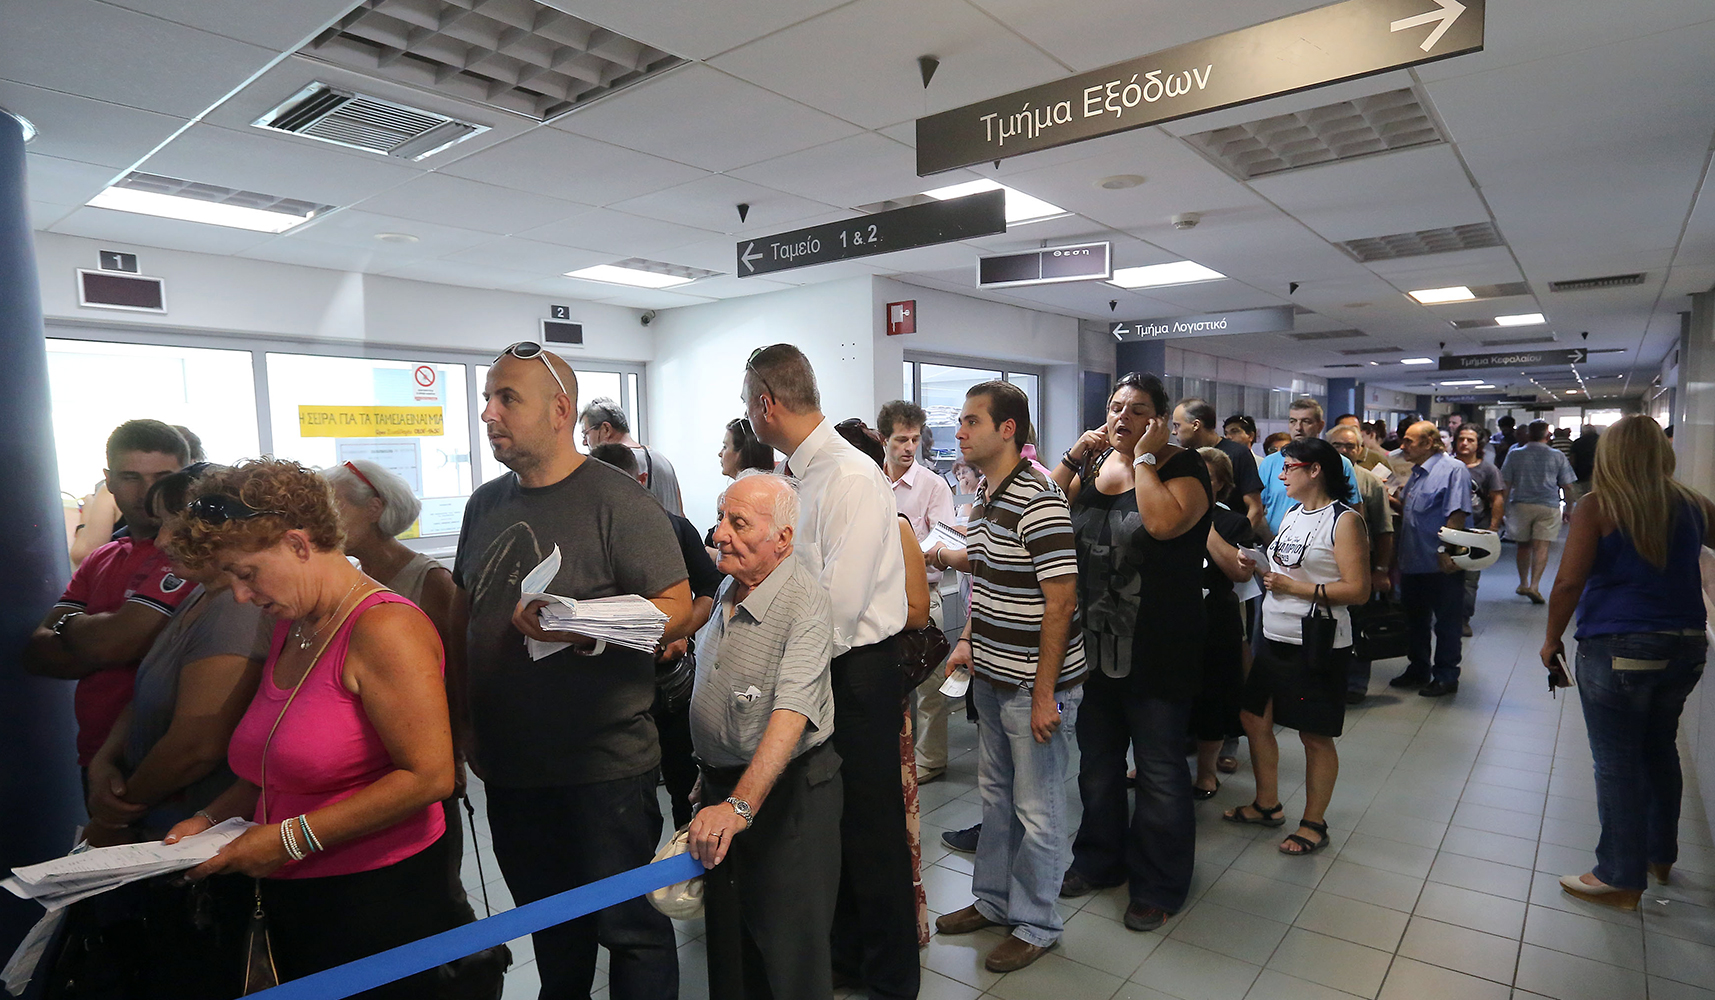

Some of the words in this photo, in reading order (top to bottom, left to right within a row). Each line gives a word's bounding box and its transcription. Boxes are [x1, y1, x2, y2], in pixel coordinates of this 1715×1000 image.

[980, 101, 1073, 146] Τμήμα
[1083, 64, 1213, 118] Εξόδων
[770, 234, 821, 261] Ταμείο
[839, 230, 848, 248] 1
[853, 231, 864, 246] &
[867, 224, 878, 243] 2
[112, 255, 122, 269] 1
[557, 307, 565, 318] 2
[1135, 323, 1169, 337] Τμήμα
[1173, 317, 1227, 333] Λογιστικό
[1460, 357, 1489, 367] Τμήμα
[1491, 353, 1542, 366] Κεφαλαίου
[307, 412, 337, 425] ΣΕΙΡΑ
[340, 412, 357, 425] ΓΙΑ
[359, 413, 373, 425] ΤΑ
